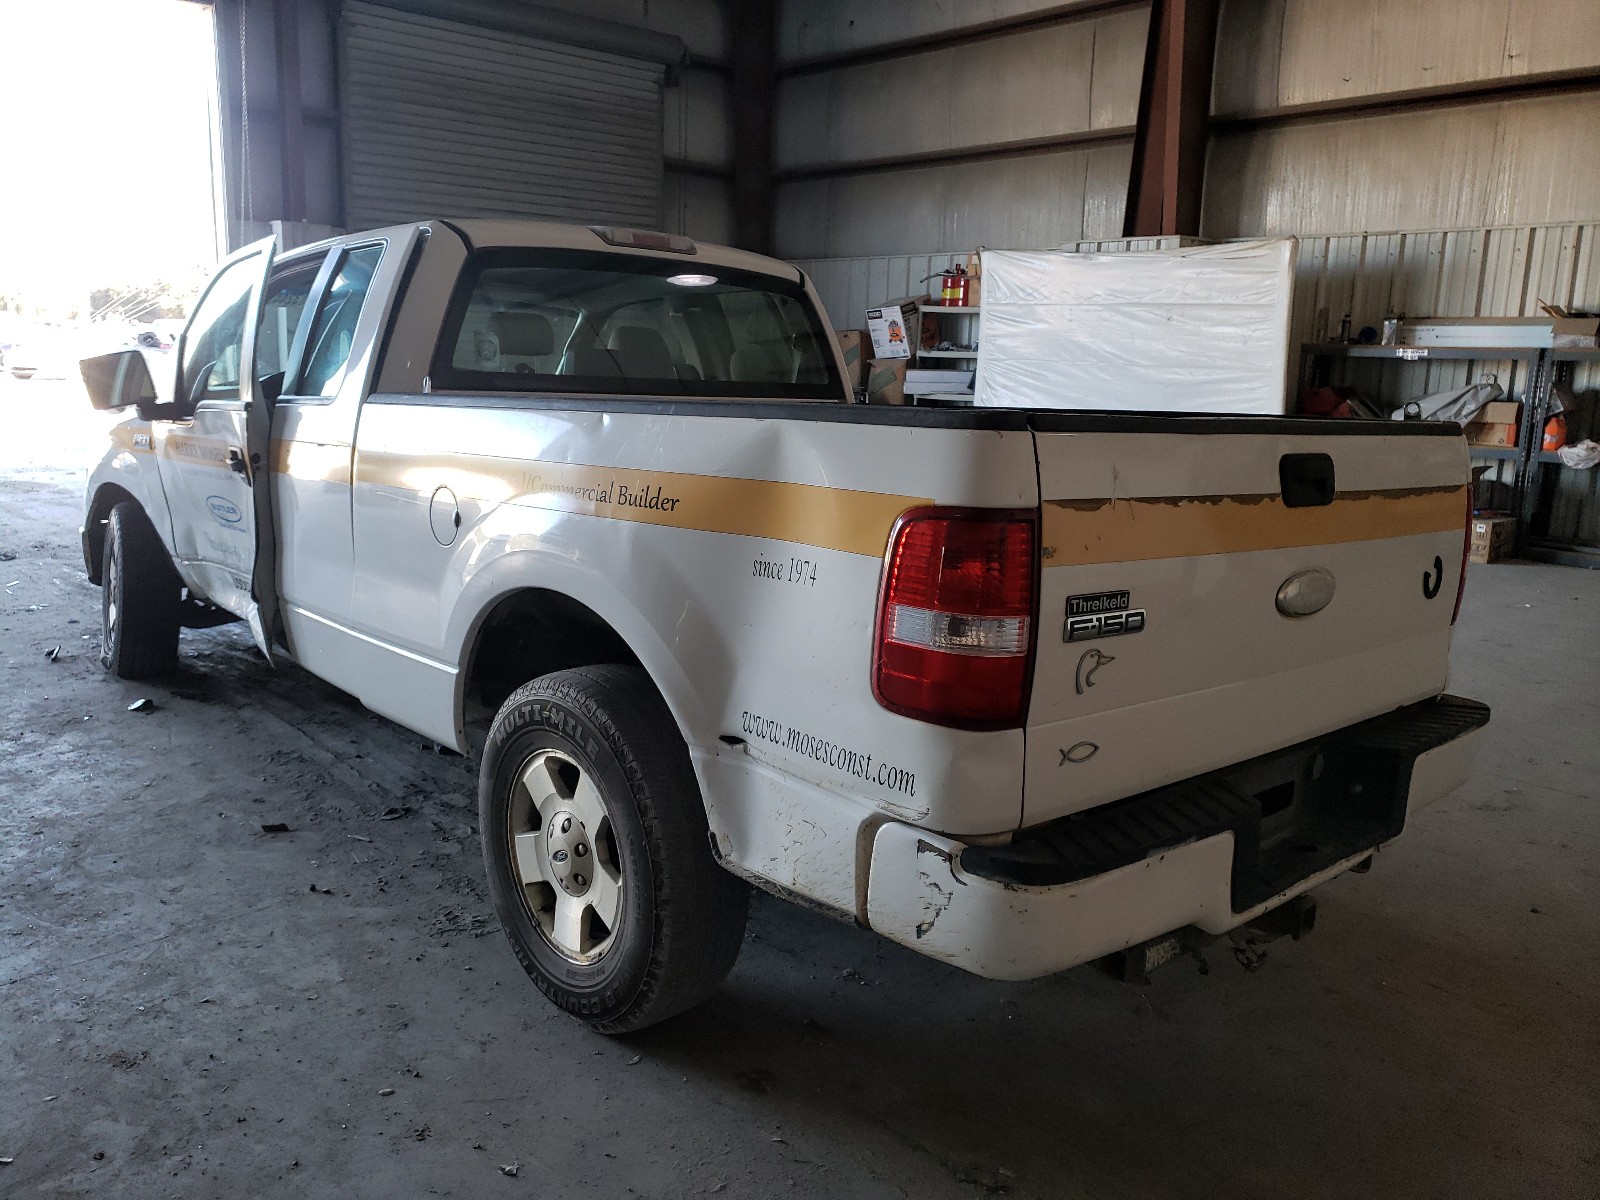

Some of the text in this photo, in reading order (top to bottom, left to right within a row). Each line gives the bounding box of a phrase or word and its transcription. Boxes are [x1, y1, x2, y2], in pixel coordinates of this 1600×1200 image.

[617, 484, 680, 512] Builder
[752, 552, 818, 588] since 1974
[1070, 594, 1129, 613] Threlkeld
[741, 710, 917, 798] www.mosesconst.com
